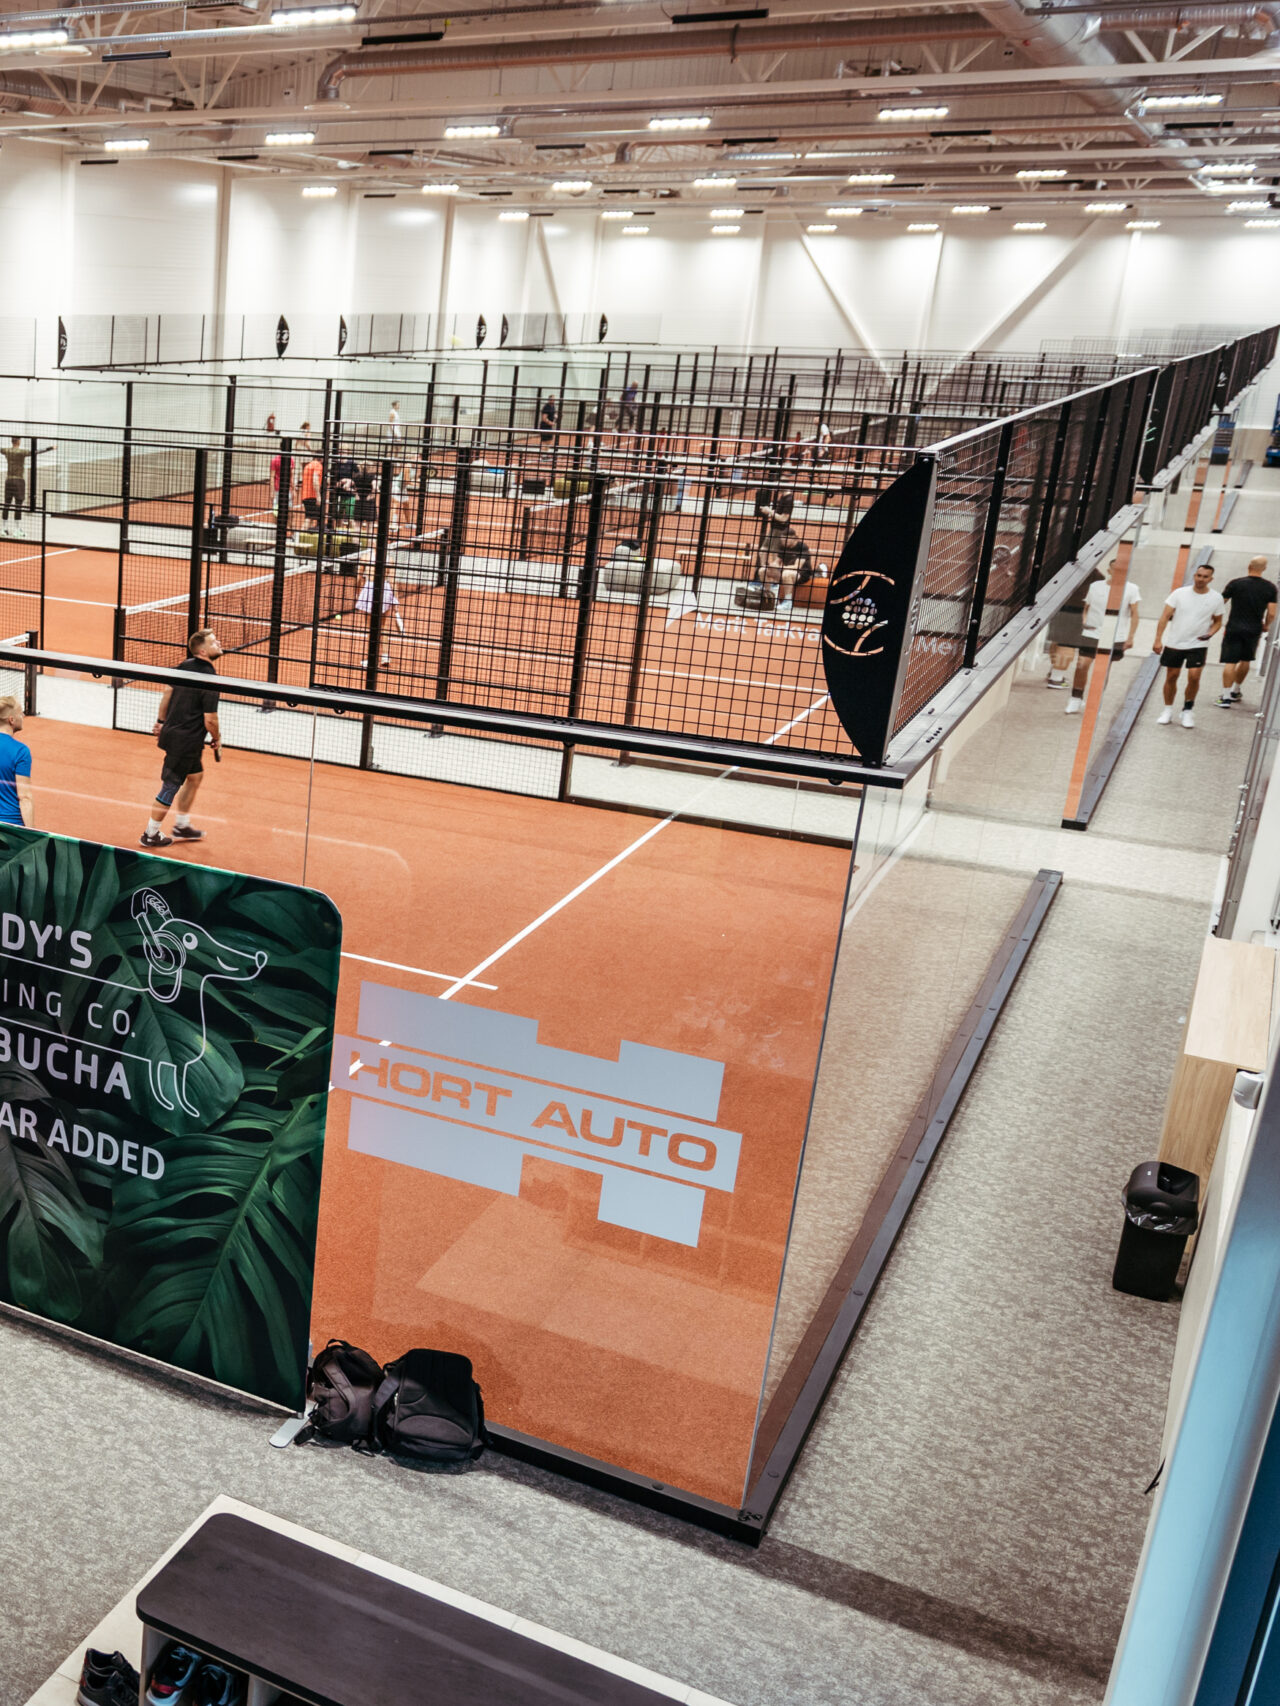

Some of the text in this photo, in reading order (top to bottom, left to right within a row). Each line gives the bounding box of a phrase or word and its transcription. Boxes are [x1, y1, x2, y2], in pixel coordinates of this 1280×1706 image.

[695, 613, 820, 641] Merit Tarkva
[87, 1002, 136, 1038] CO.
[349, 1050, 718, 1172] HORT AUTO
[47, 1118, 165, 1180] ADDED
